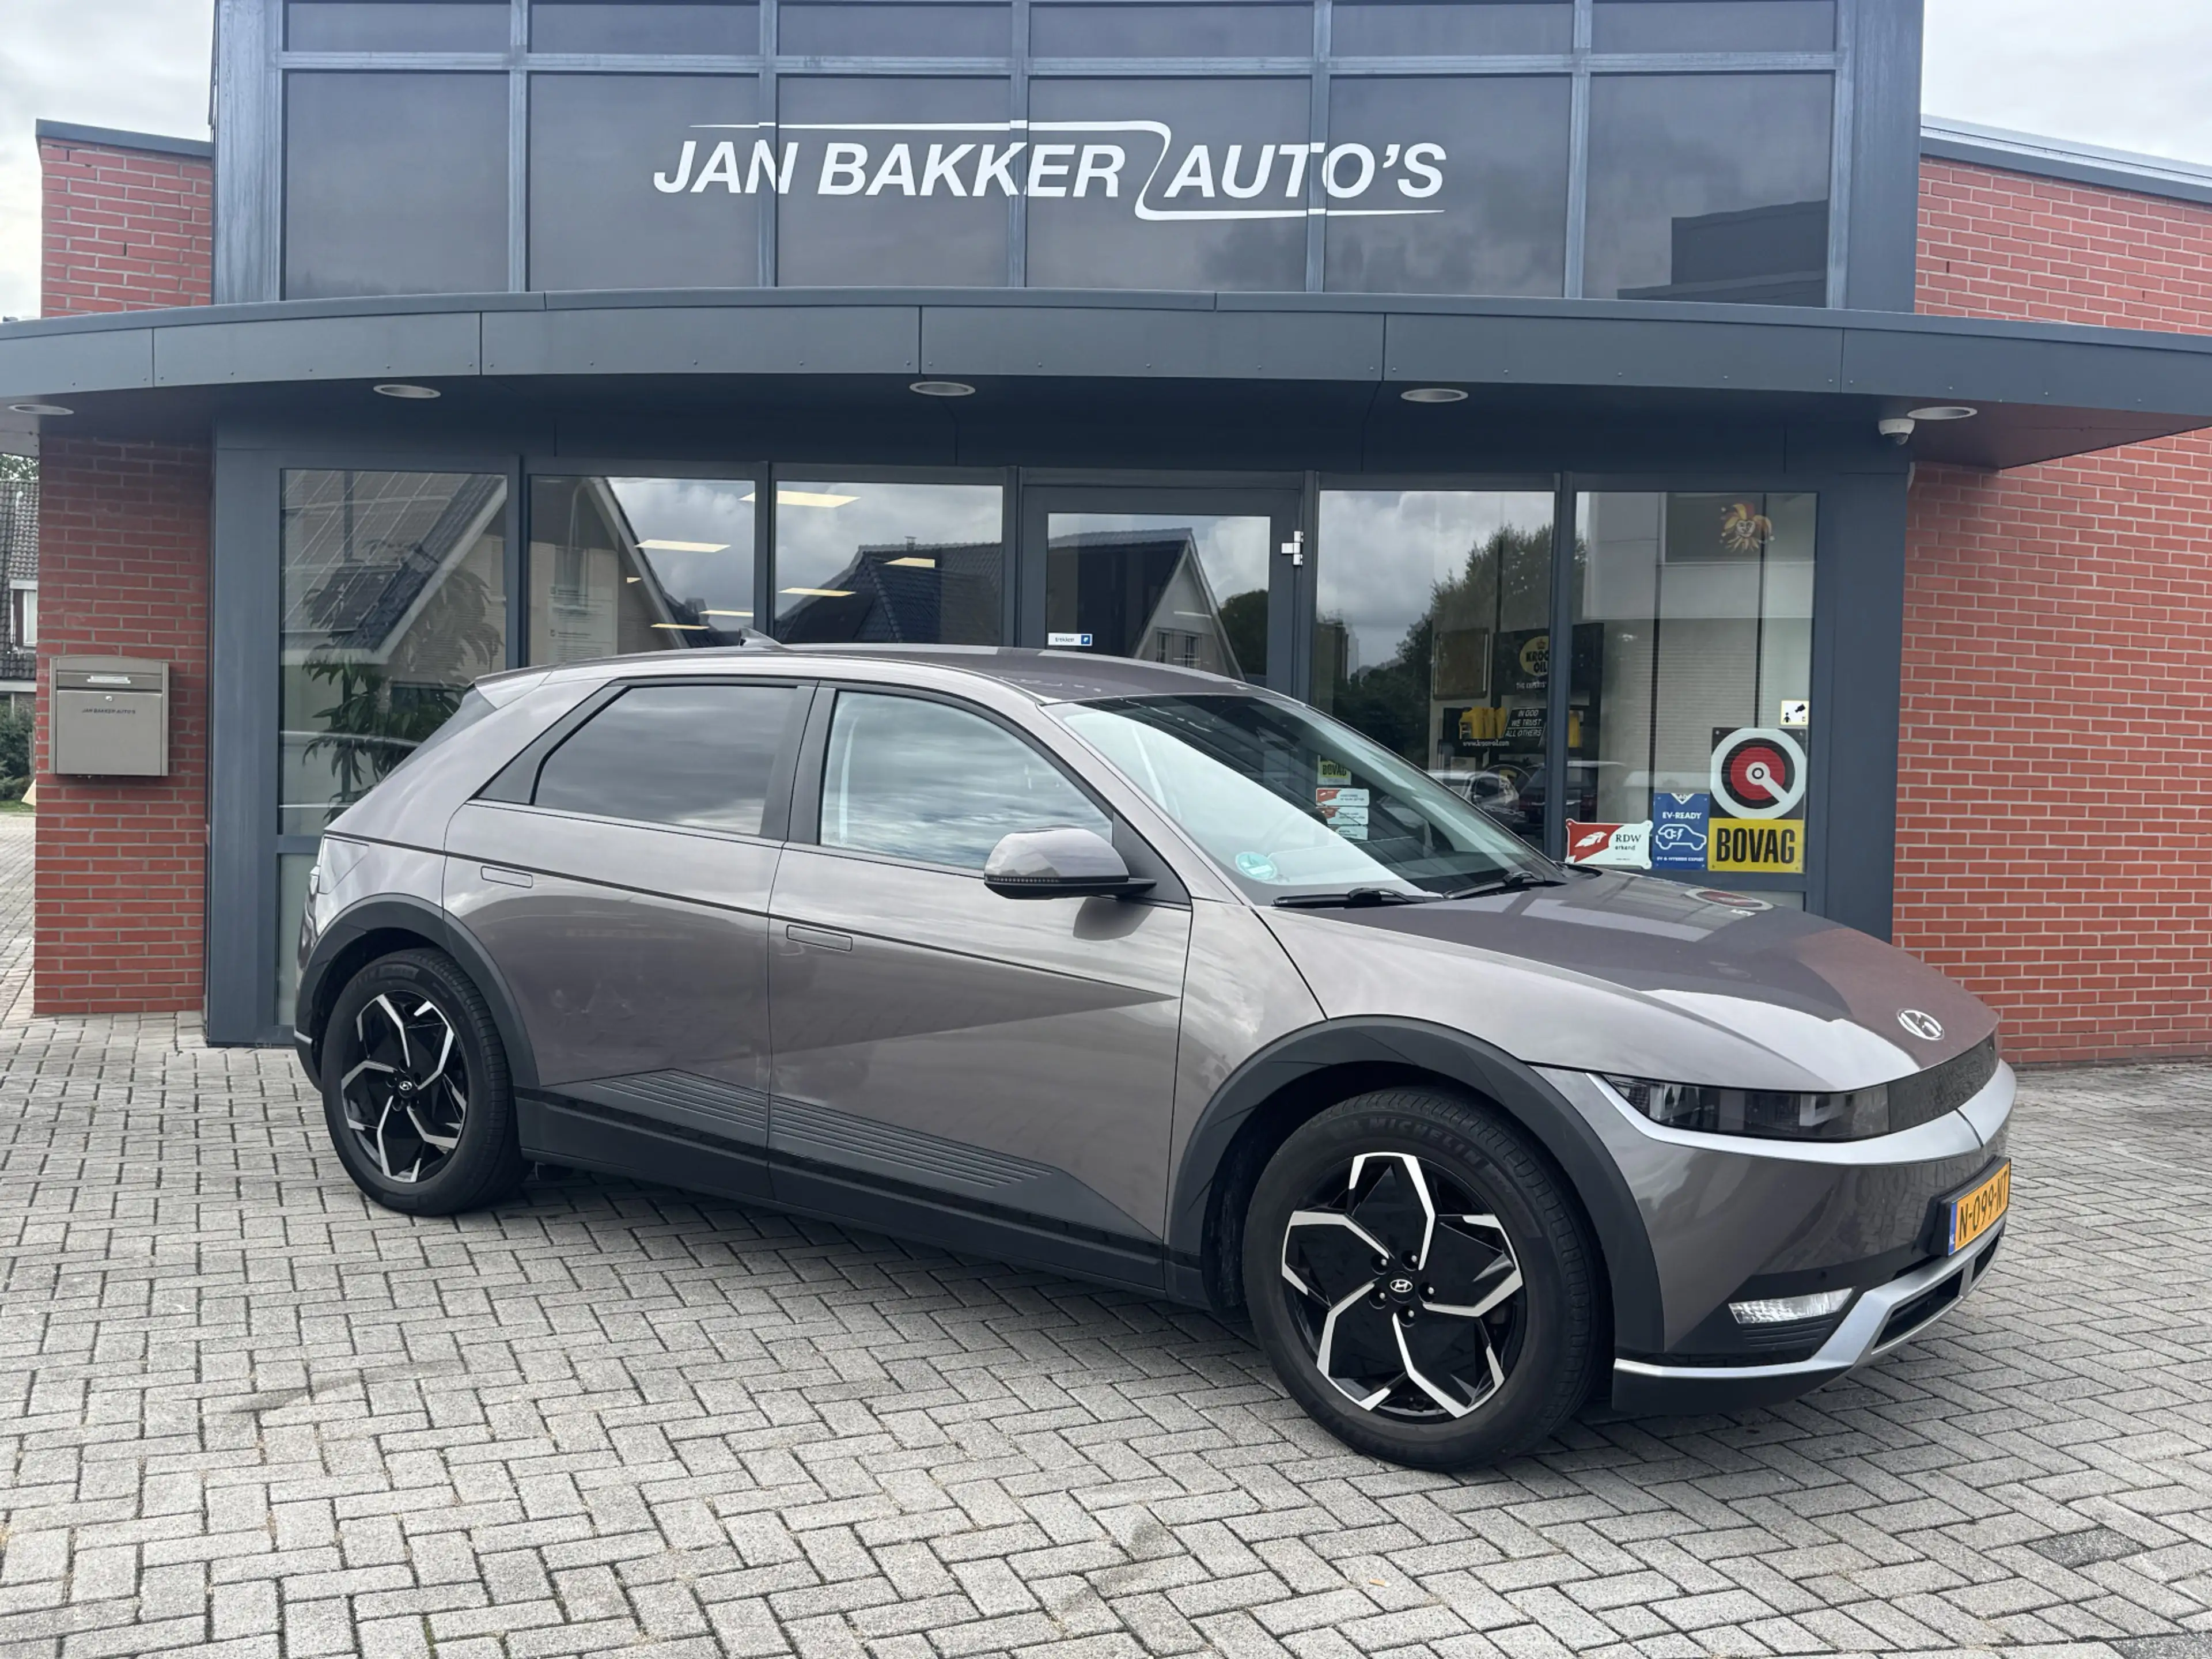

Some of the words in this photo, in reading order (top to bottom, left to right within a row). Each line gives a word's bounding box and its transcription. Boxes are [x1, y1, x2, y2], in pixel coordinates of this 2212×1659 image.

[653, 141, 798, 195] JAN
[817, 142, 1126, 198] BAKKER
[1163, 142, 1447, 198] AUTO'S
[1526, 650, 1550, 662] KROO
[1533, 661, 1547, 673] OIL
[1522, 718, 1542, 726] TRUST
[1505, 729, 1516, 737] ALL
[1517, 729, 1542, 737] OTHERS
[1615, 834, 1641, 843] RDW
[1716, 827, 1796, 864] BOVAG
[1369, 1118, 1485, 1167] MICHELIN
[1959, 1171, 2008, 1242] N-099-NT
